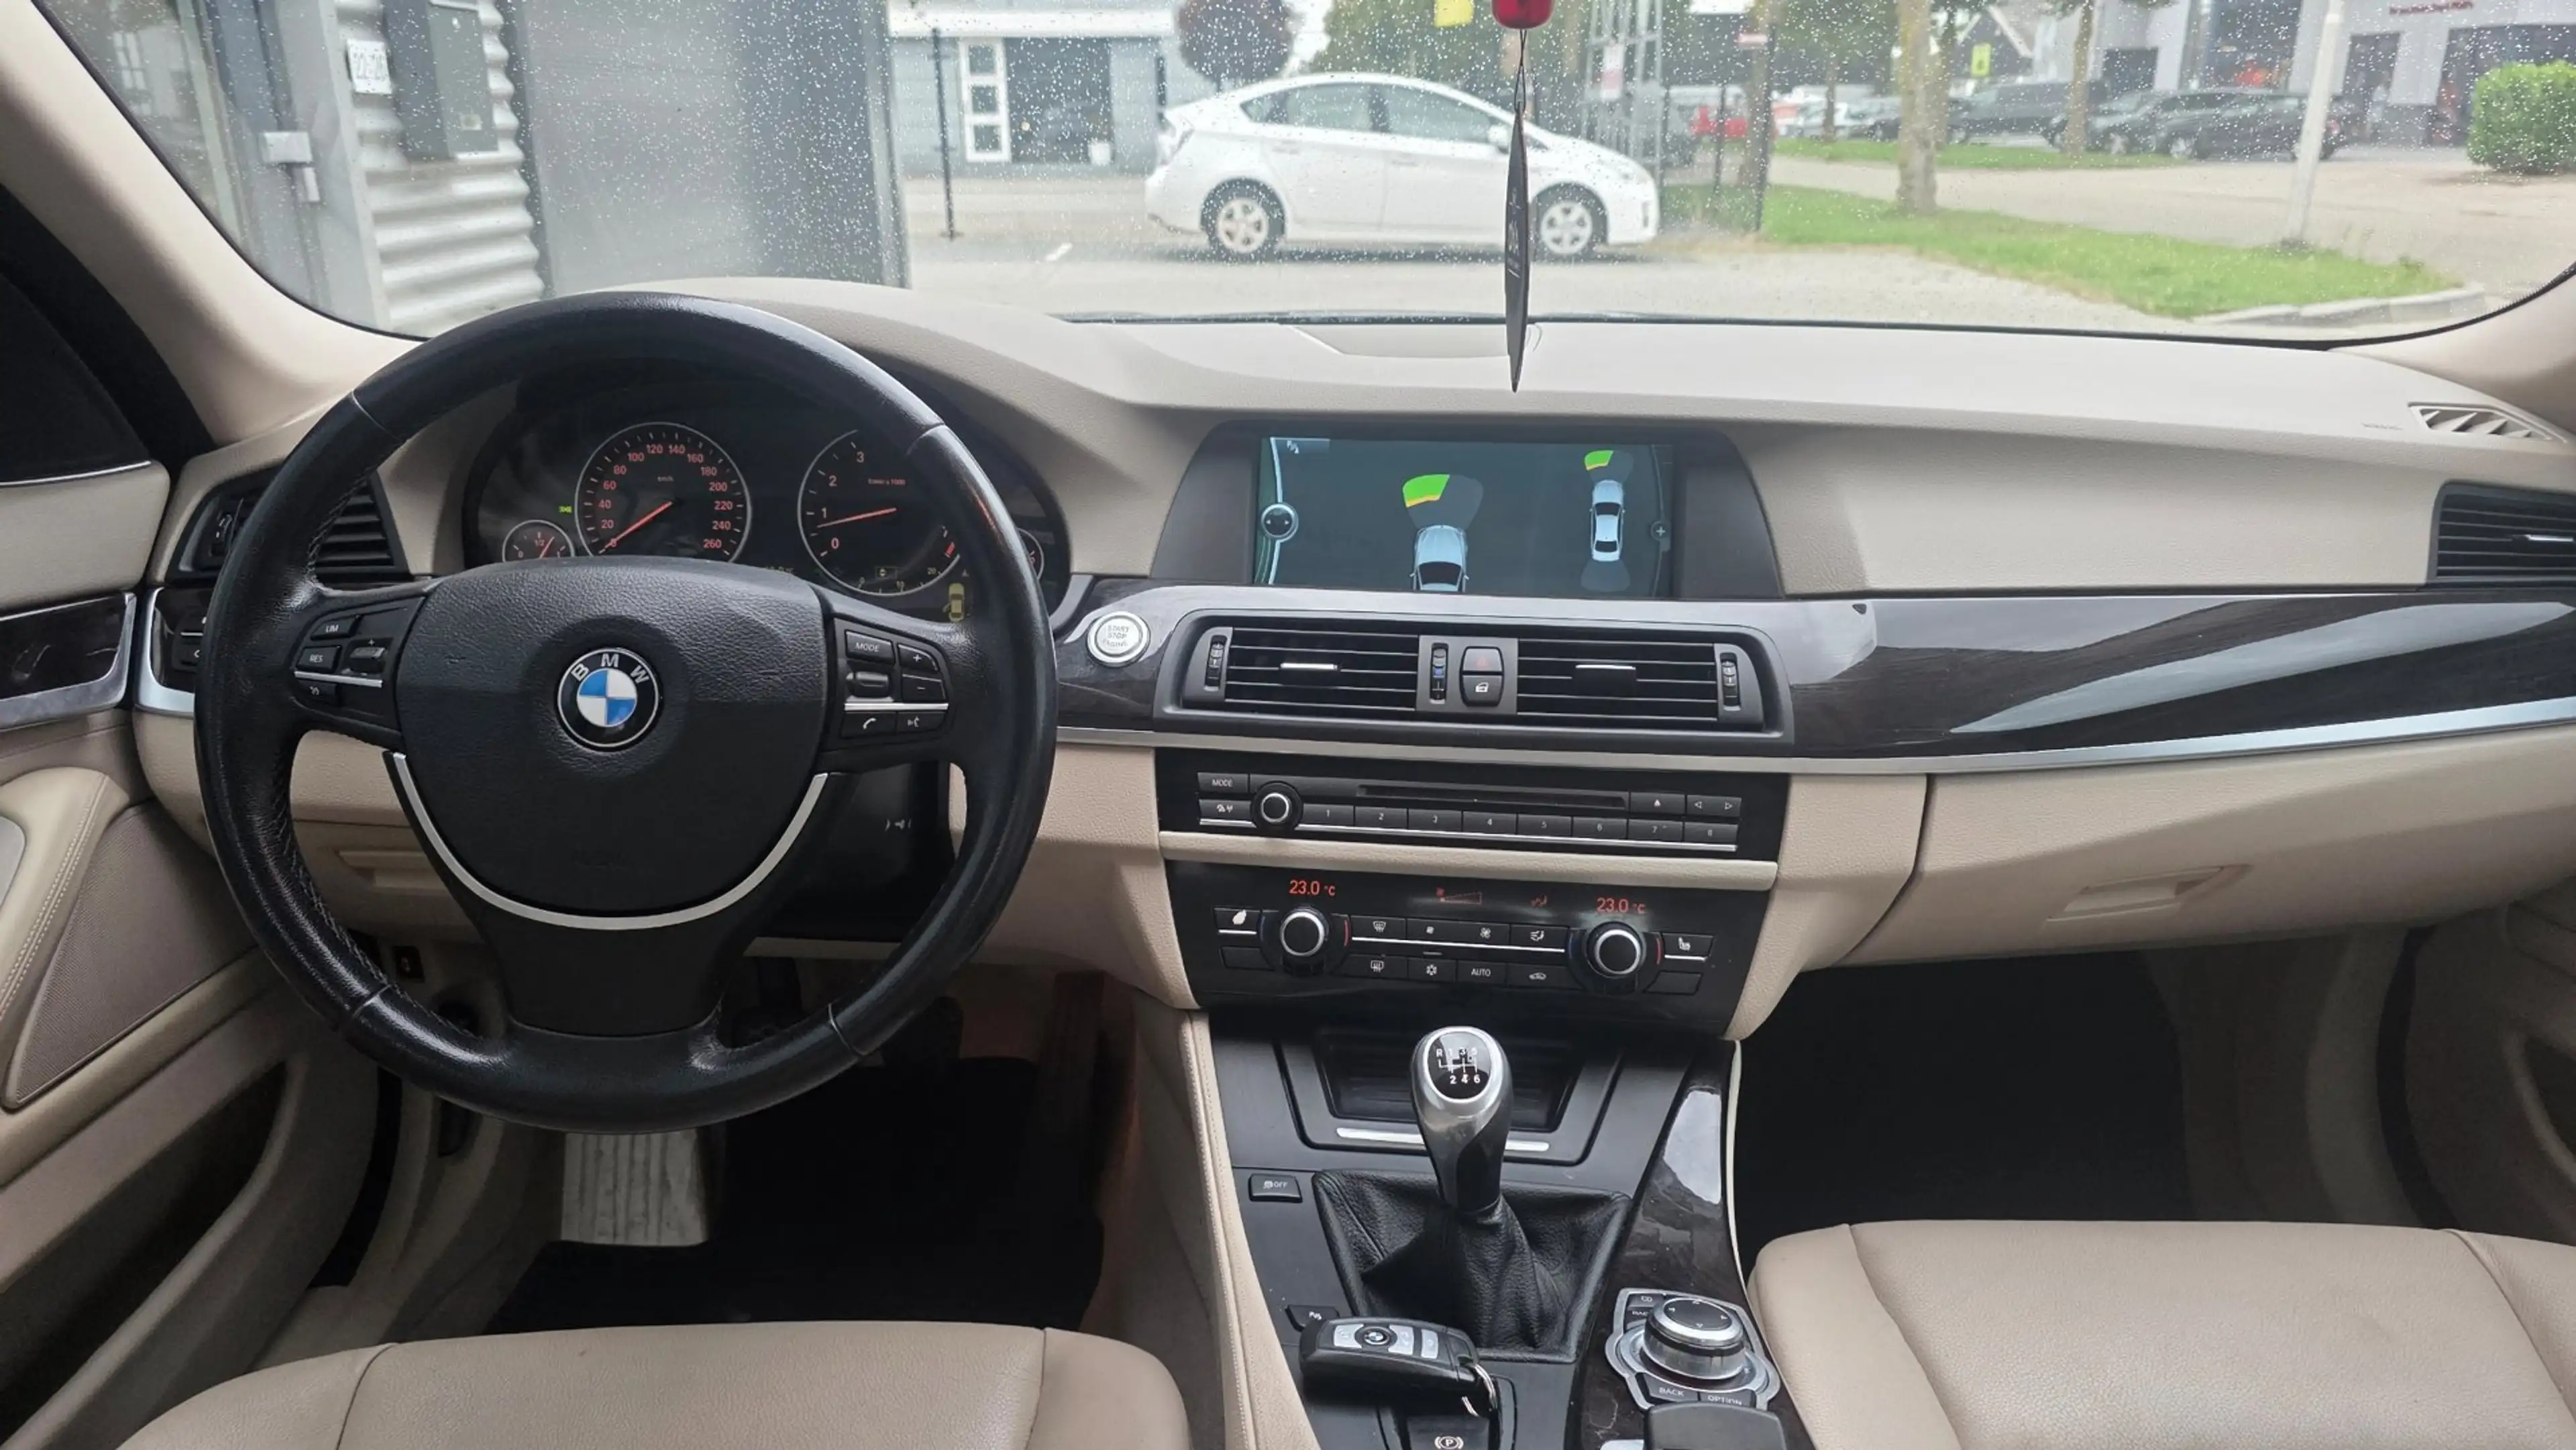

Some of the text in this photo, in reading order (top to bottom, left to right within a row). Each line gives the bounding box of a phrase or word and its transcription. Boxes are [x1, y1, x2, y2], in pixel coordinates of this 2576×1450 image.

[646, 444, 663, 454] 120
[668, 444, 686, 455] 140
[628, 452, 645, 462] 100
[687, 453, 704, 464] 160
[857, 451, 865, 463] 3
[613, 464, 627, 475] 80
[701, 466, 717, 476] 180
[603, 480, 616, 490] 60
[708, 481, 728, 492] 200
[828, 475, 837, 487] 2
[598, 499, 612, 509] 40
[714, 500, 733, 511] 220
[821, 507, 827, 519] 1
[601, 519, 614, 529] 20
[712, 520, 731, 531] 240
[703, 538, 722, 549] 260
[830, 537, 839, 550] 0
[325, 624, 339, 633] LIM
[855, 641, 879, 652] MODE
[309, 654, 323, 663] RES
[571, 654, 649, 684] BMW
[1212, 778, 1234, 788] MODE
[1326, 809, 1330, 817] 1
[1379, 812, 1385, 821] 2
[1432, 814, 1438, 823] 3
[1597, 823, 1603, 831] 6
[1652, 825, 1658, 833] 7
[1289, 880, 1320, 896] 23.0
[1597, 897, 1629, 913] 23.0
[1471, 968, 1491, 977] AUTO
[1436, 1048, 1443, 1057] R
[1459, 1047, 1466, 1055] 3
[1449, 1074, 1481, 1084] 2 4 6
[1274, 1181, 1288, 1189] OFF
[1659, 1387, 1684, 1397] BACK
[1707, 1395, 1742, 1406] OPTION
